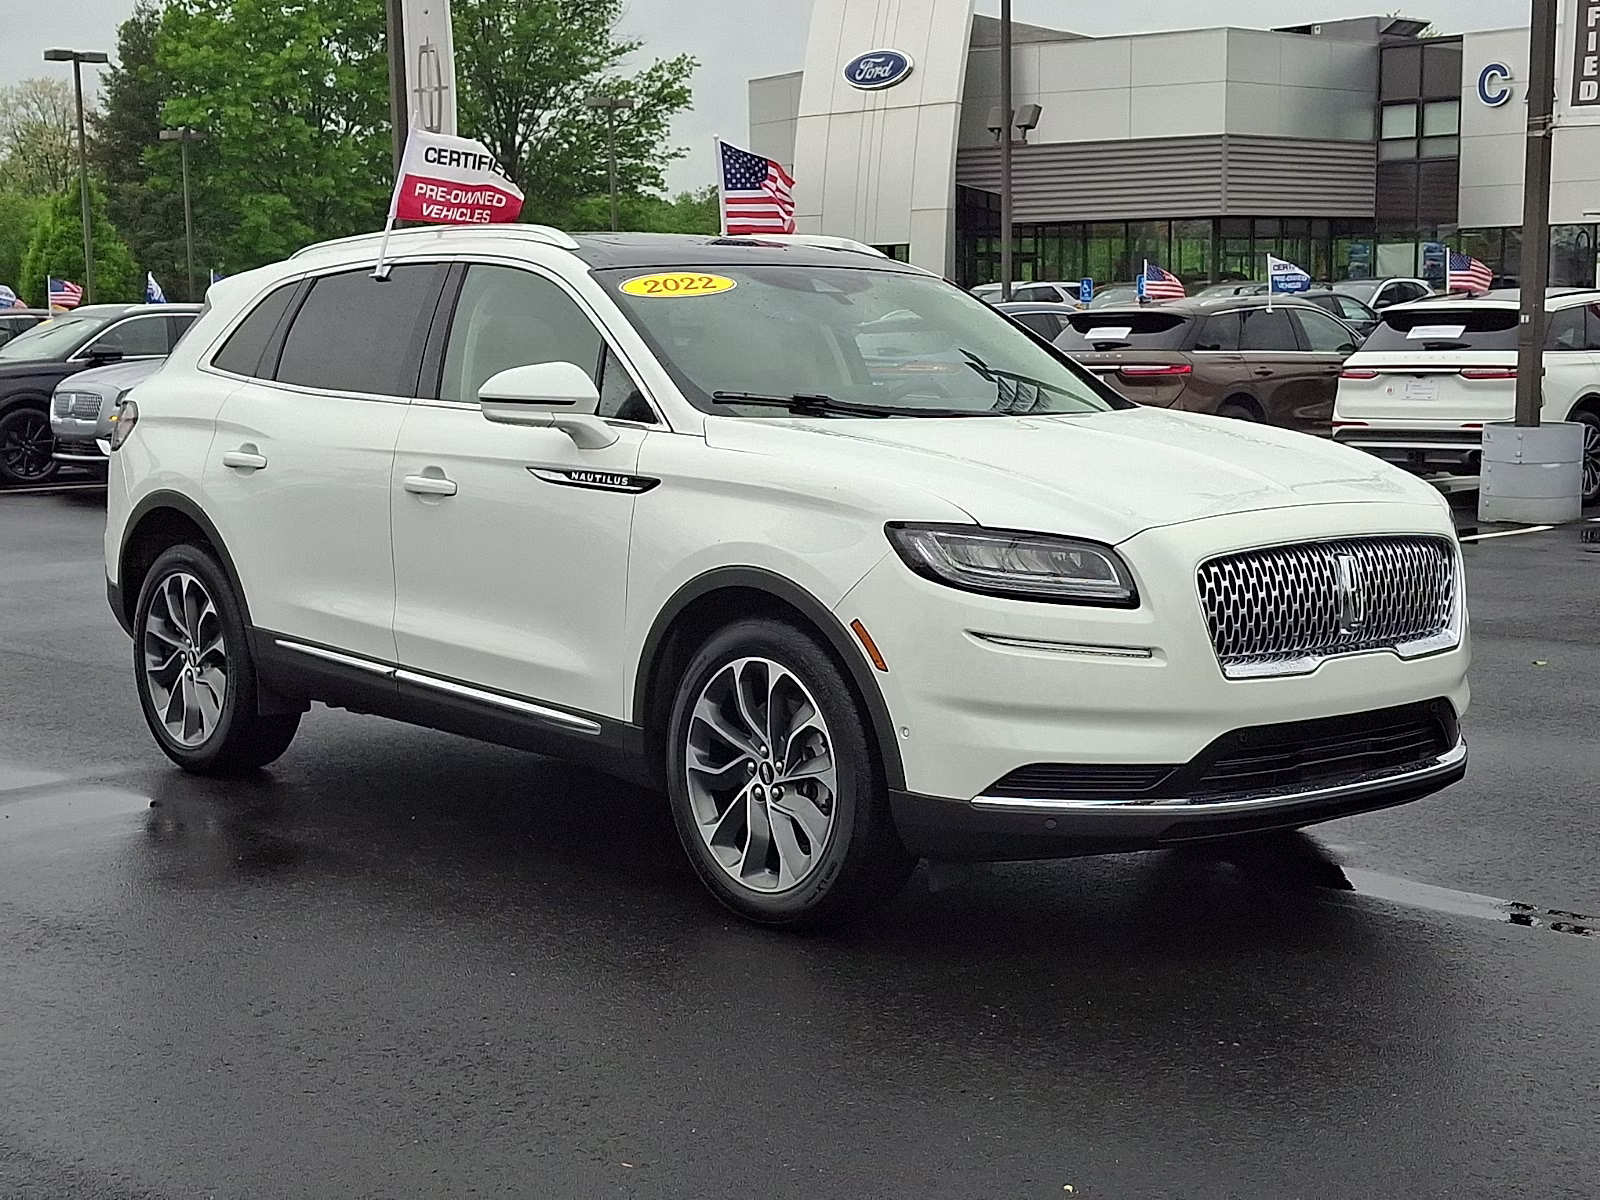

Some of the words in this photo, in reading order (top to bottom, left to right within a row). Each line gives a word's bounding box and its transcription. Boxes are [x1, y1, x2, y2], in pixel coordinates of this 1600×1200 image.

[1578, 0, 1600, 101] FIED
[855, 57, 894, 80] Ford
[415, 183, 507, 207] PRE-OWNED
[422, 203, 491, 223] VEHICLES
[643, 276, 717, 293] 2022
[571, 471, 628, 486] NAUTILUS
